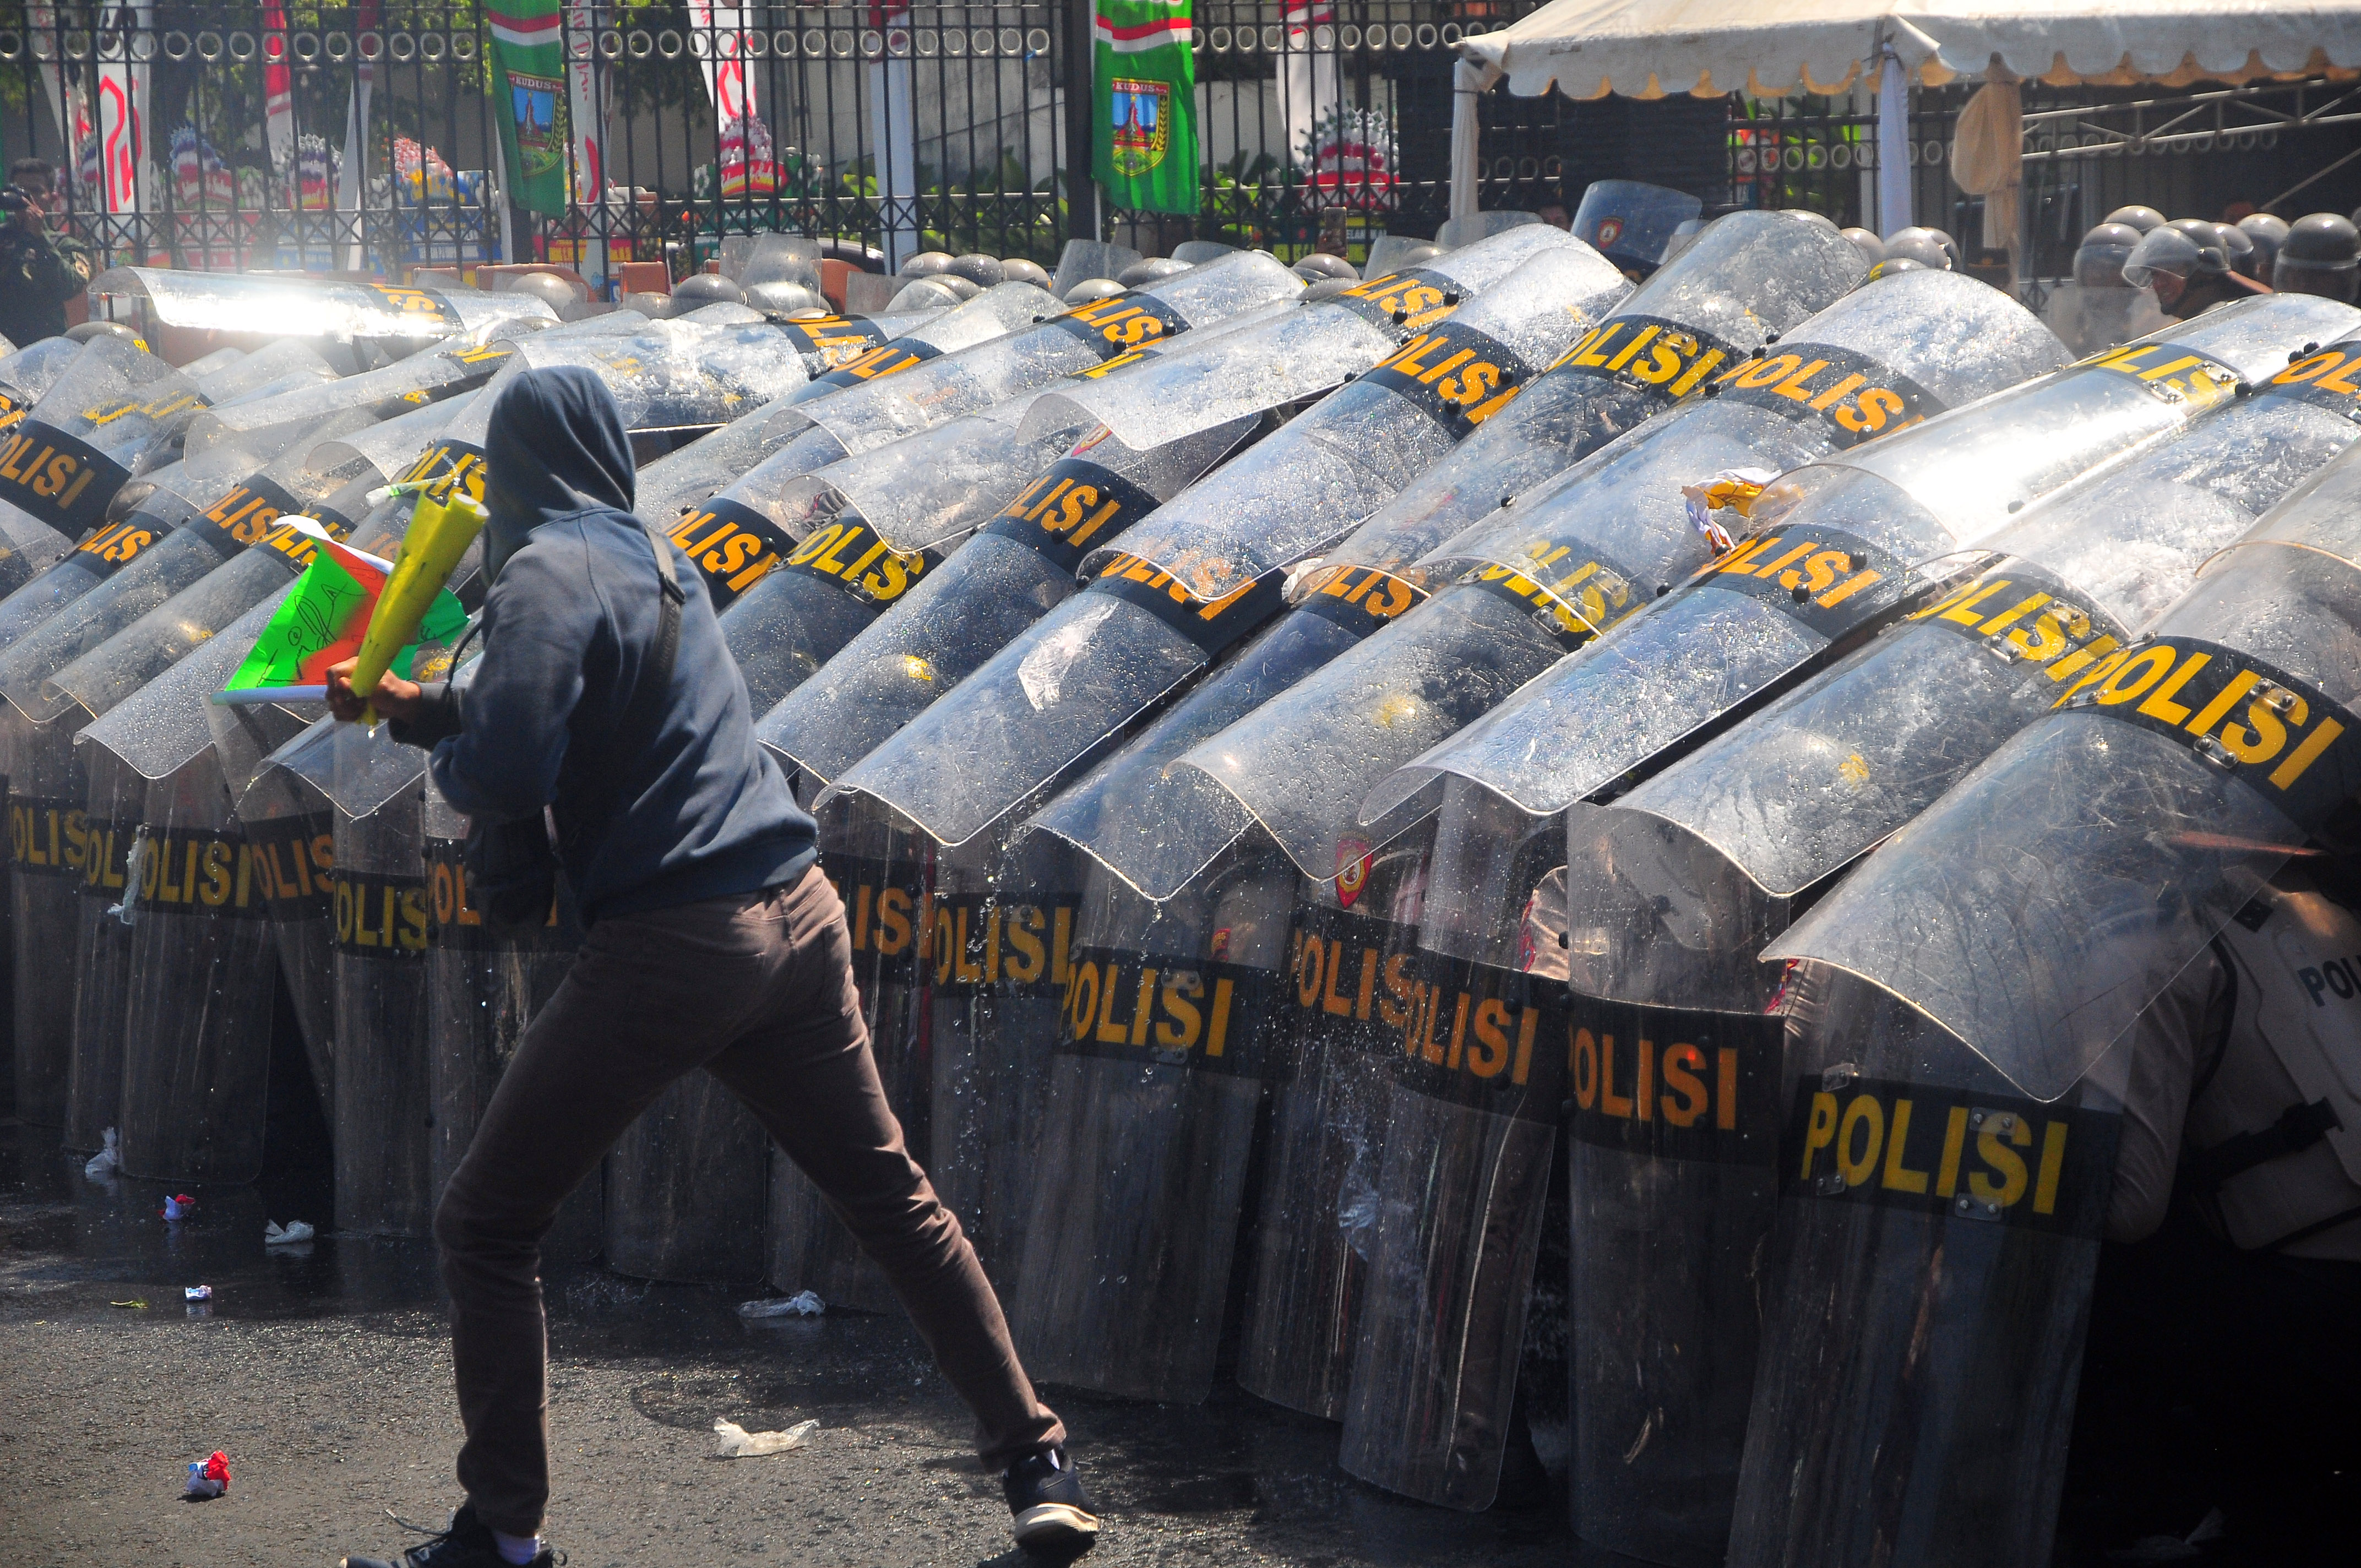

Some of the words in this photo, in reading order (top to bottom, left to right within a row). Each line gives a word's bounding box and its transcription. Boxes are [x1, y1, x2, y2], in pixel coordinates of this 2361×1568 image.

[515, 76, 551, 89] KUDUS
[1114, 81, 1155, 92] KUDUS
[1373, 334, 1520, 424] OLISI
[1545, 323, 1726, 397] OLISI
[662, 510, 781, 592] OLISI
[2050, 645, 2345, 792] POLISI
[142, 835, 252, 908] OLISI
[935, 906, 1071, 986] OLISI
[1404, 979, 1539, 1086] OLISI
[1568, 1023, 1738, 1131] OLISI
[1801, 1091, 2069, 1215] POLISI
